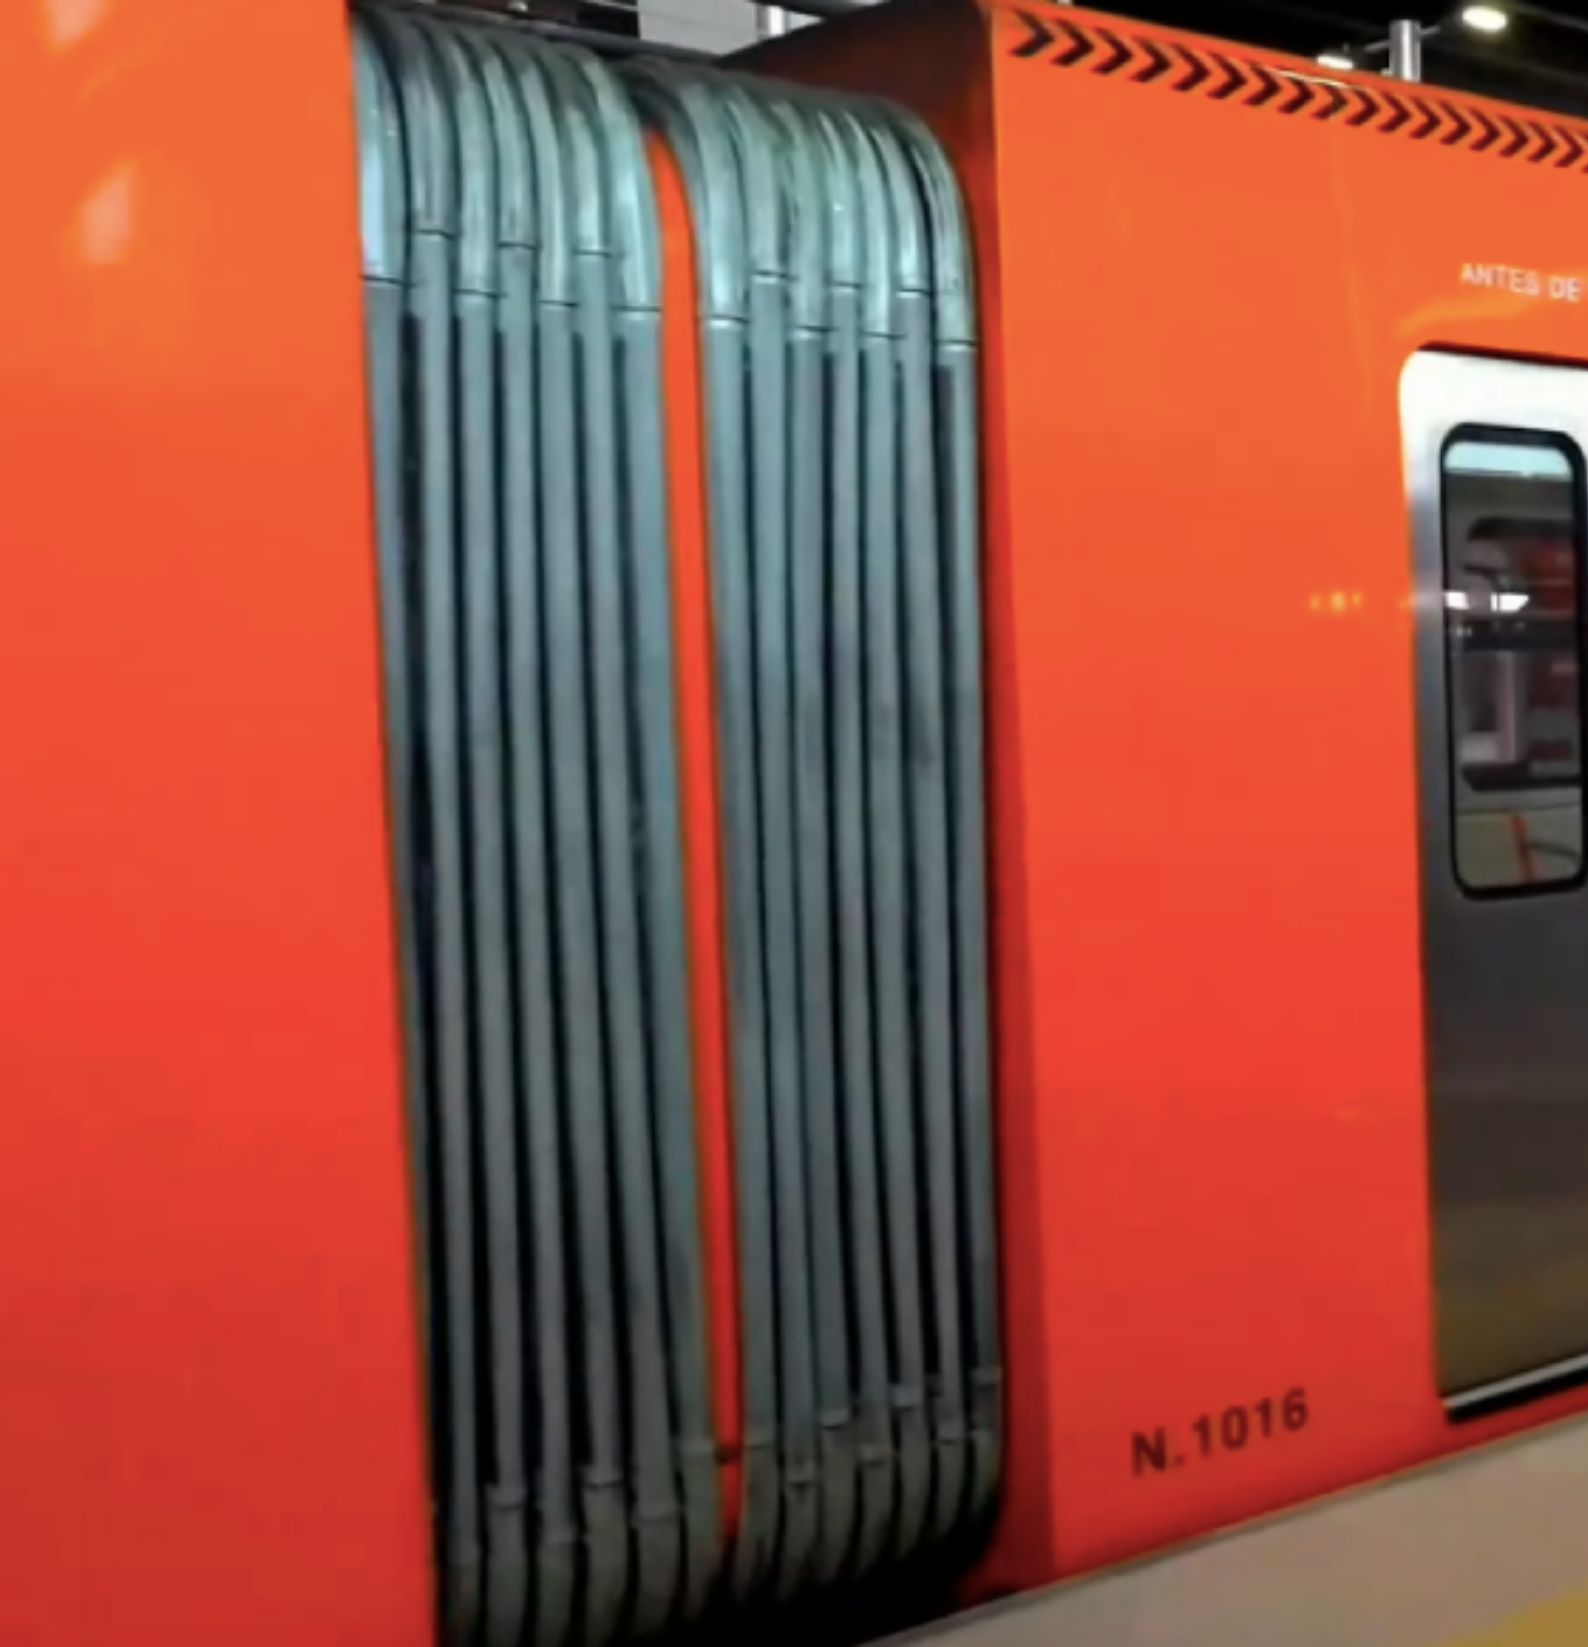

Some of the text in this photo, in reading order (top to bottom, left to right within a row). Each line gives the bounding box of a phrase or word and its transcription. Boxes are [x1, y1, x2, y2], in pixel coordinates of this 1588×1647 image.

[1460, 263, 1540, 296] ANTES
[1549, 275, 1581, 302] DE
[1131, 1385, 1309, 1479] N.1016
